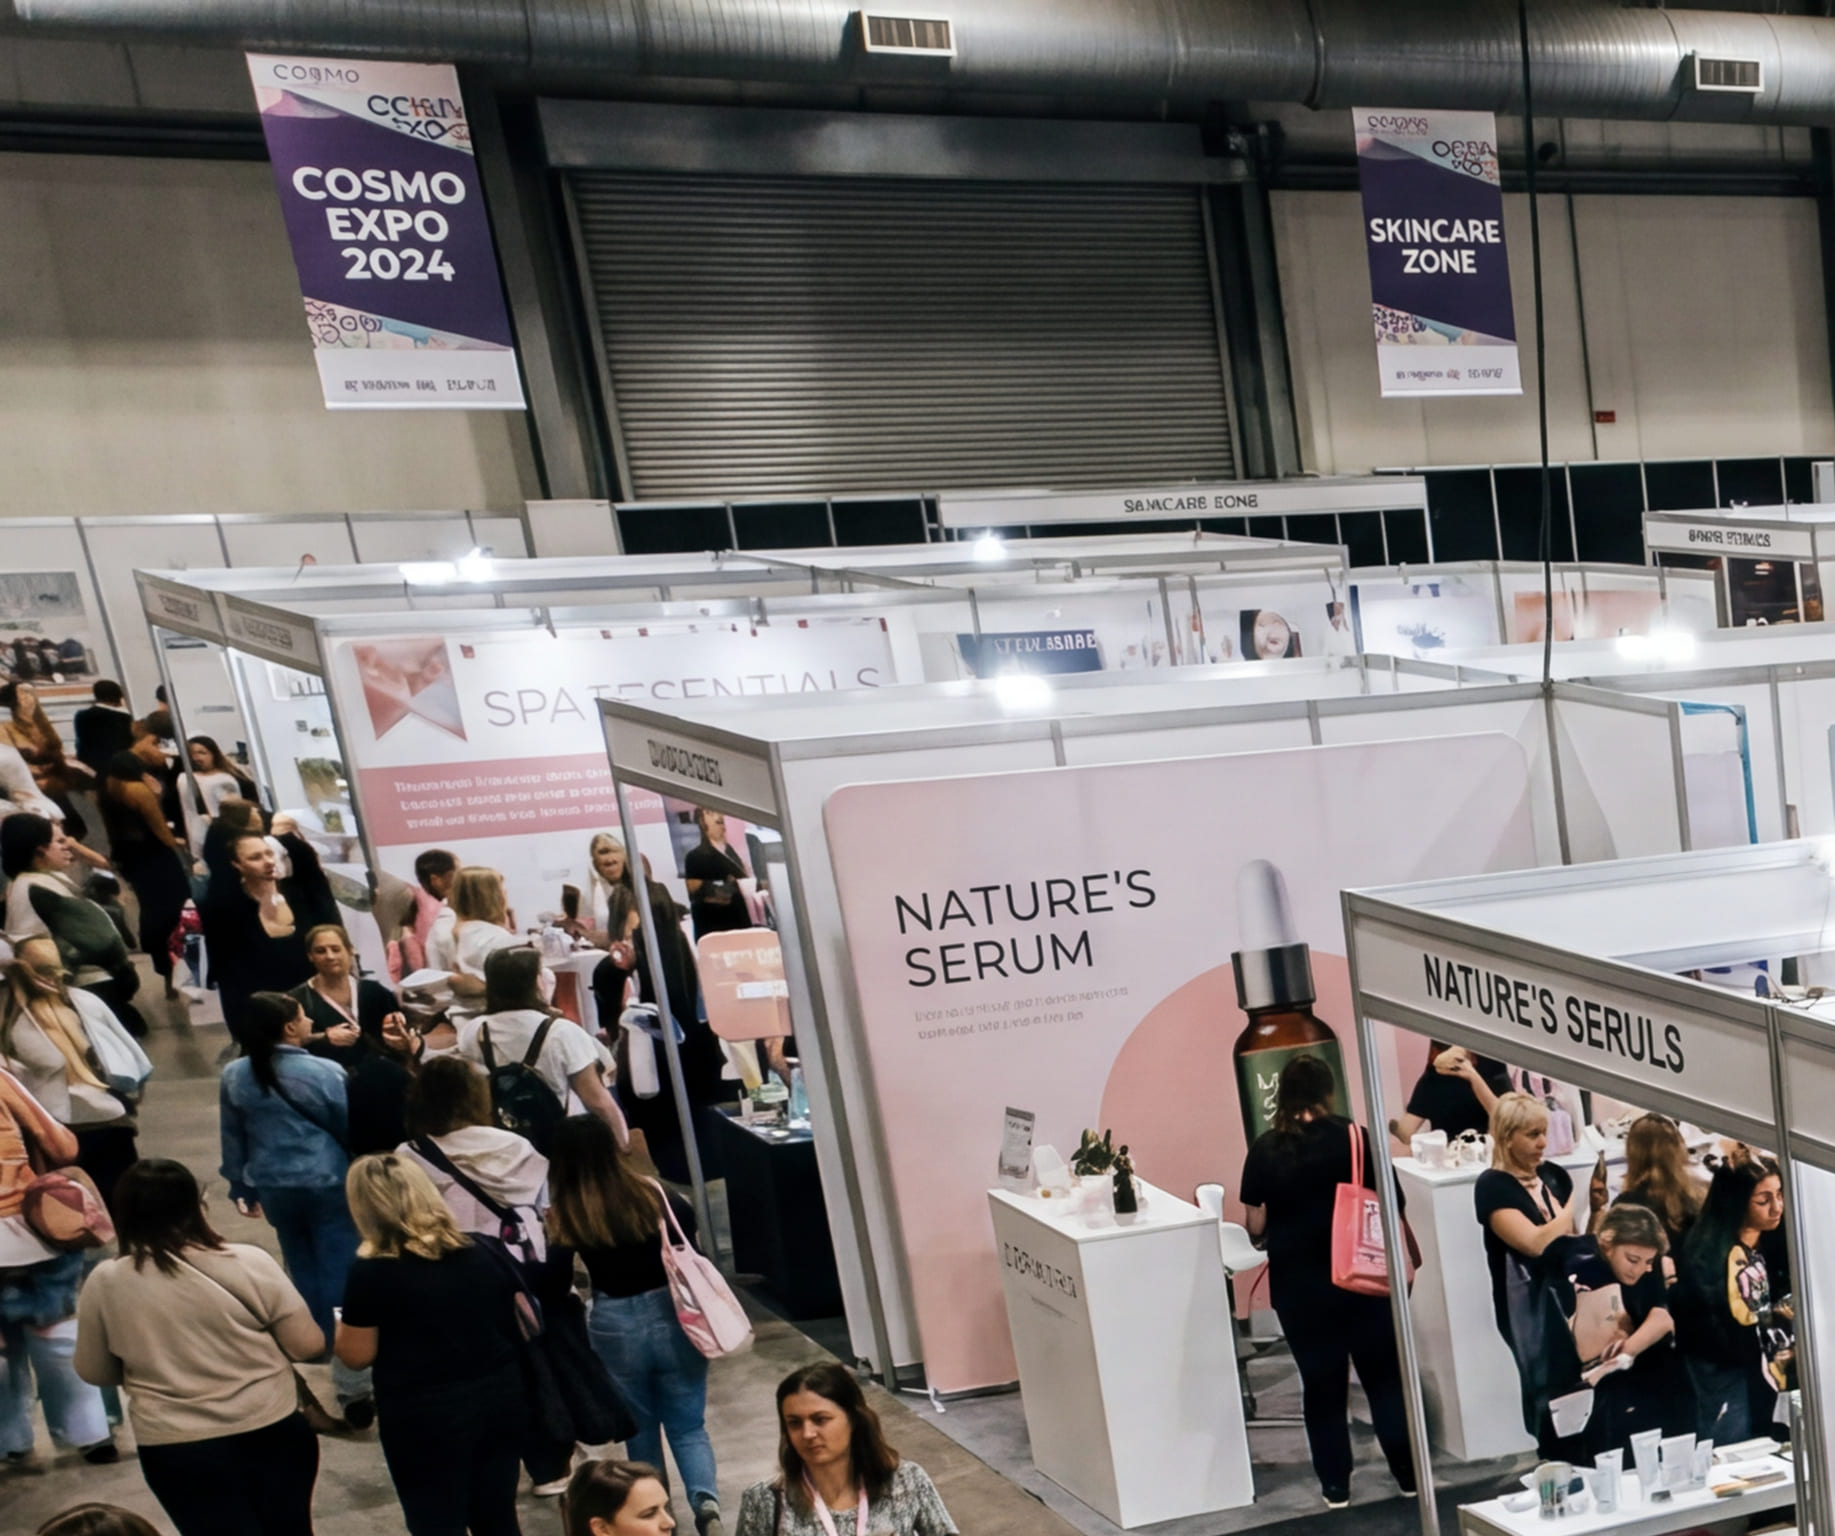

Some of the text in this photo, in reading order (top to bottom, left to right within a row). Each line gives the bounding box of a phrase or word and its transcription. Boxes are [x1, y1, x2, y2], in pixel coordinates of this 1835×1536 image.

[292, 166, 466, 205] COSMO
[325, 206, 449, 243] EXPO
[1370, 217, 1501, 244] SKINCARE
[341, 247, 456, 282] 2024
[1401, 248, 1478, 275] ZONE
[482, 686, 588, 728] SPA
[894, 868, 1158, 936] NATURE'S
[904, 929, 1094, 988] SERUM
[1422, 952, 1686, 1076] NATURE'S SERULS
